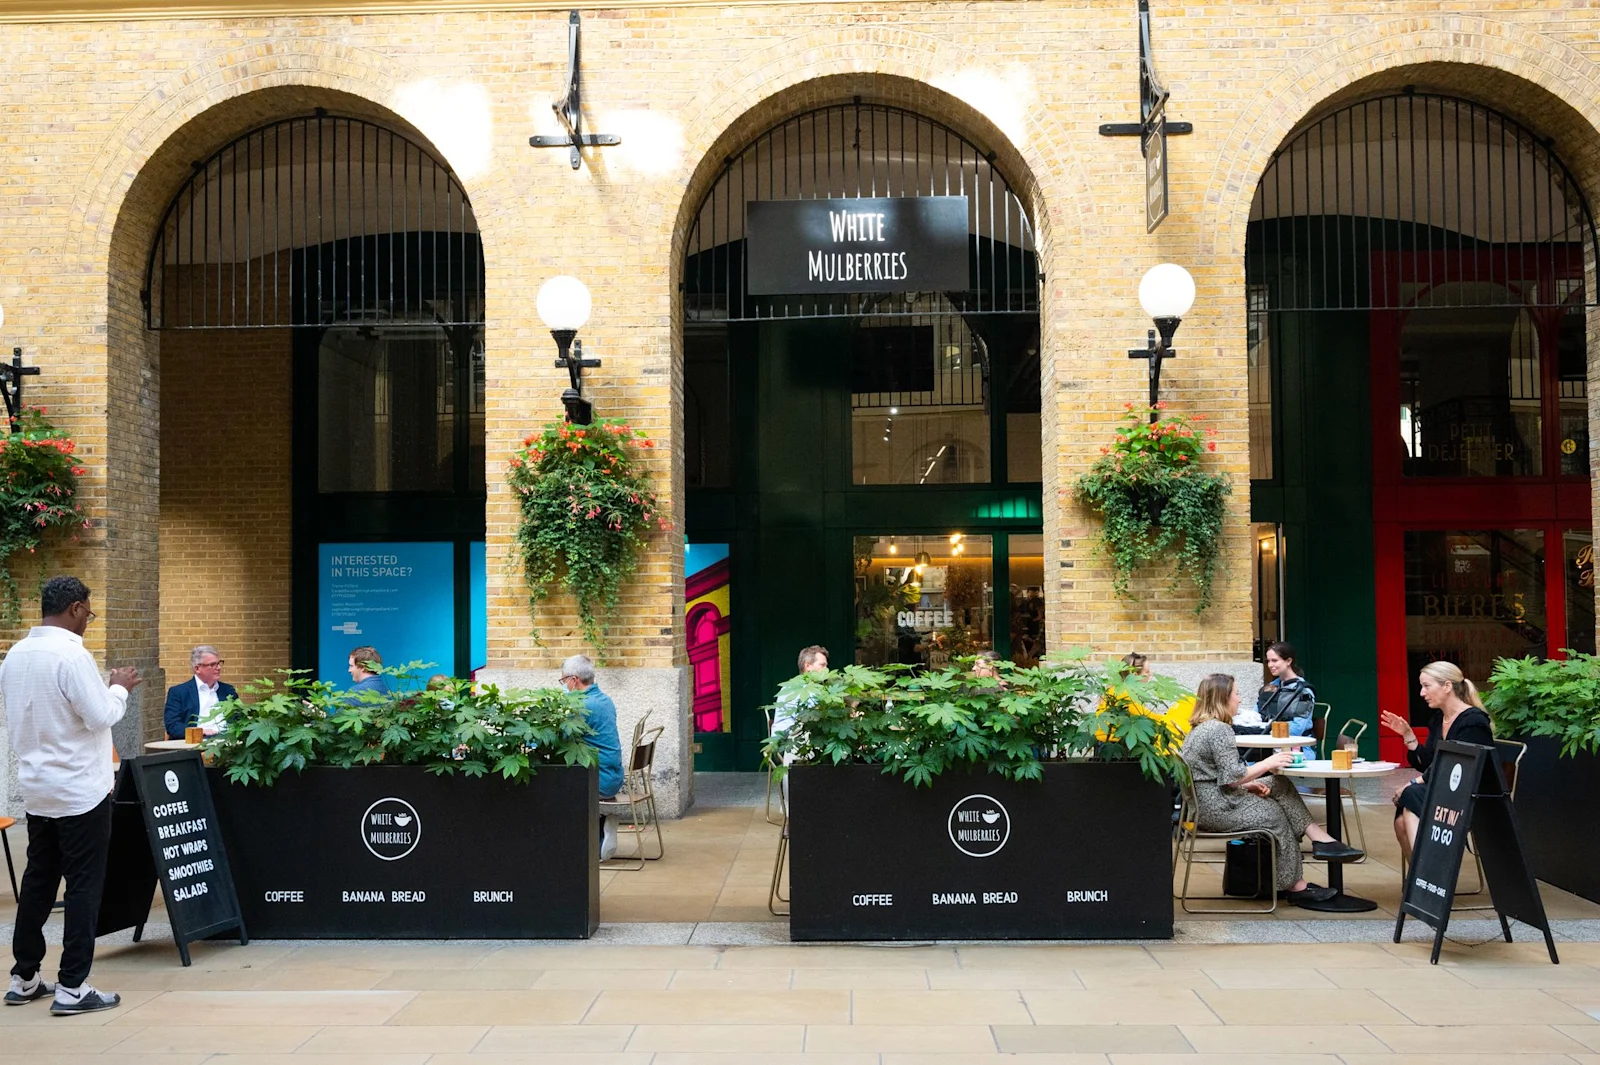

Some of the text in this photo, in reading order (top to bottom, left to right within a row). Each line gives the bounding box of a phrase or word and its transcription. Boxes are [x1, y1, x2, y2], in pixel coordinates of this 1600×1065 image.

[829, 209, 885, 242] WHITE
[809, 250, 907, 282] MULBERRIES
[332, 555, 397, 565] INTERESTED
[332, 567, 412, 577] IN THIS SPACE?
[897, 611, 954, 628] COFFEE
[153, 801, 189, 818] COFFEE
[1434, 806, 1449, 822] EAT
[371, 814, 392, 826] WHITE
[958, 811, 979, 823] WHITE
[158, 818, 207, 839] BREAKFAST
[370, 831, 411, 845] MULBERRIES
[958, 830, 1001, 842] MULBERRIES
[1431, 825, 1453, 846] TO GO
[163, 839, 208, 860] HOT WRAPS
[168, 859, 213, 880] SMOOTHIES
[173, 882, 208, 901] SALADS
[265, 891, 304, 903] COFFEE
[343, 891, 426, 903] BANANA BREAD
[474, 891, 513, 903] BRUNCH
[1067, 891, 1108, 903] BRUNCH
[853, 894, 892, 907] COFFEE
[932, 892, 1019, 905] BANANA BREAD
